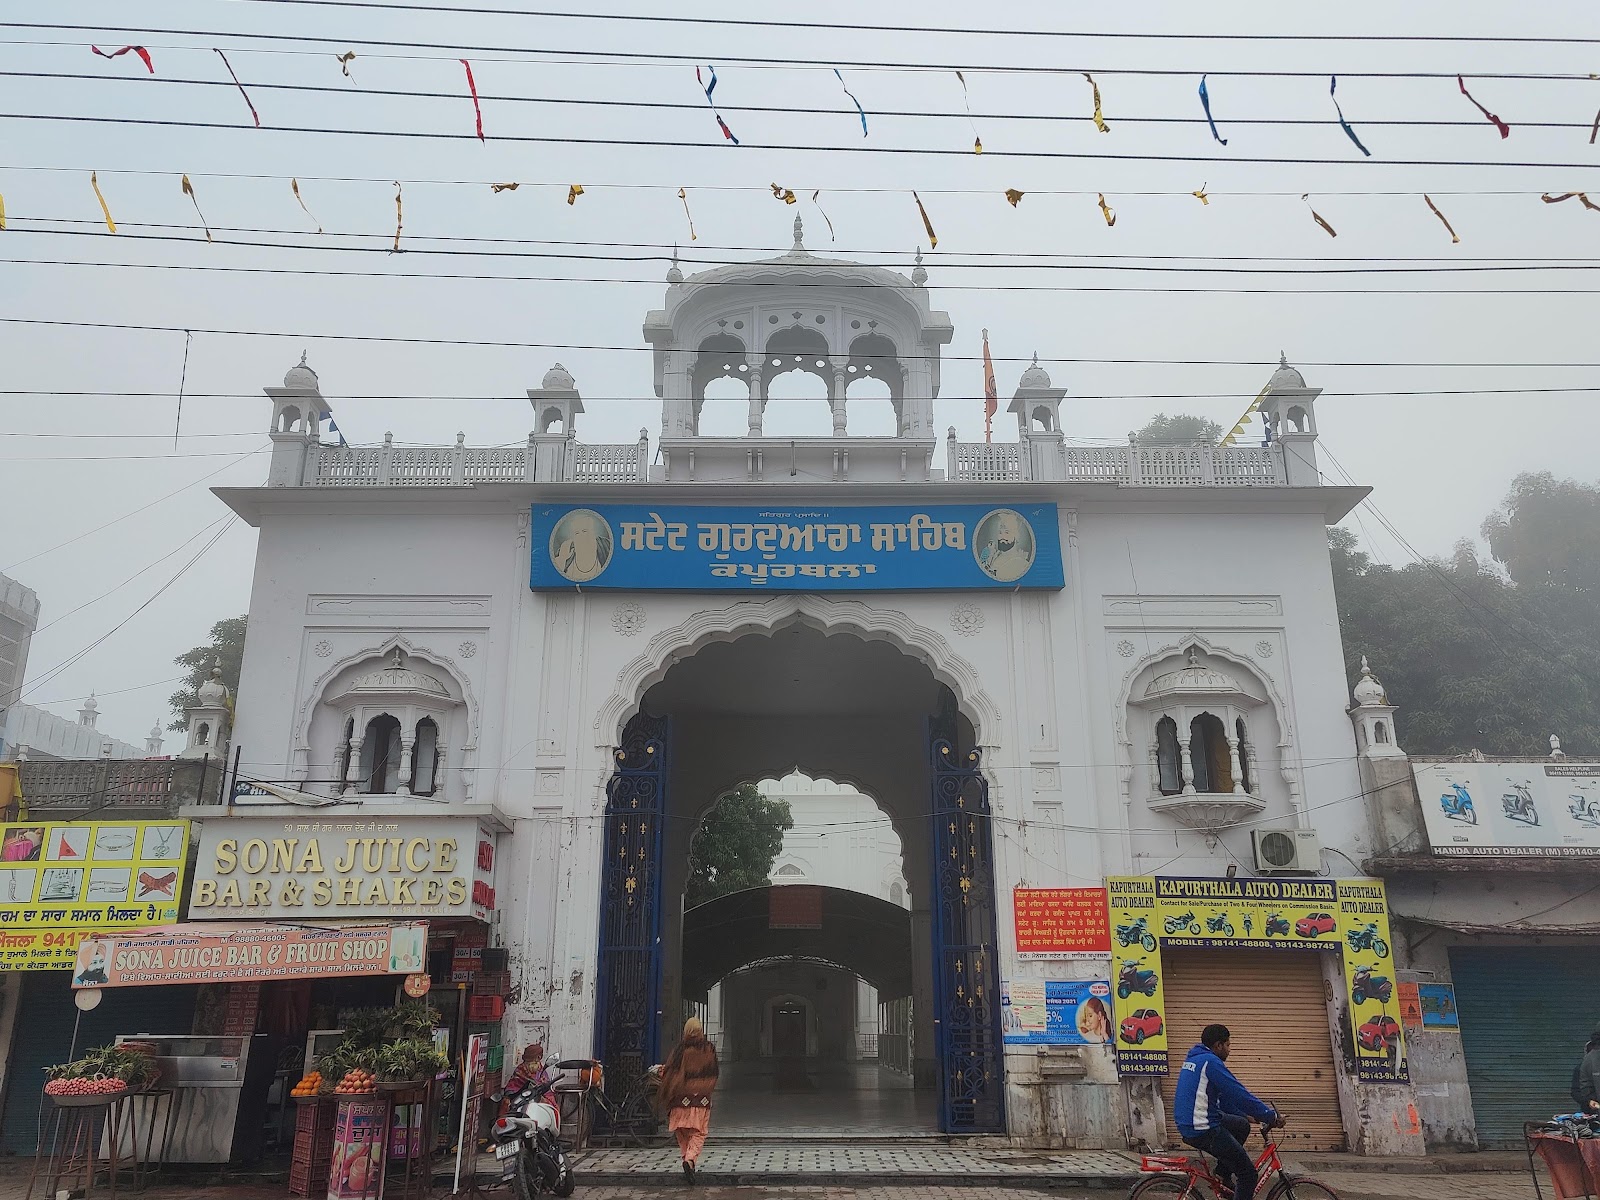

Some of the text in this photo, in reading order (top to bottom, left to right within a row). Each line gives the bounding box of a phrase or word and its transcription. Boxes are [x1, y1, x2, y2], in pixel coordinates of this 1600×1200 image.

[620, 513, 966, 560] ਸਟੇਟ ਗੁਰਦੁਆਰਾ ਸਾਹਿਬ
[709, 563, 878, 585] ਕਪੂਰਥਲਾ
[284, 824, 292, 832] 50
[214, 838, 324, 874] SONA
[334, 838, 458, 873] JUICE
[1473, 848, 1500, 856] AUTO
[1503, 848, 1543, 856] DEALER
[1546, 848, 1561, 857] (M)
[192, 878, 272, 908] BAR
[279, 878, 305, 907] &
[312, 876, 467, 906] SHAKES
[1110, 882, 1154, 894] KAPURTHALA
[1159, 880, 1334, 899] KAPURTHALA AUTO DEALER
[1340, 886, 1383, 898] KAPURTHALA
[1111, 896, 1155, 908] AUTO DEALER
[1341, 902, 1385, 914] AUTO DEALER
[0, 910, 20, 922] ਰਮ
[24, 910, 37, 922] ਦਾ
[41, 910, 67, 922] ਸਾਰਾ
[71, 910, 102, 922] ਸਮਾਨ
[106, 906, 142, 921] ਮਿਲਦਾ
[1167, 938, 1204, 946] MOBILE
[1275, 941, 1335, 950] 98143-98745
[115, 940, 388, 971] SONA JUICE BAR & FRUIT SHOP
[1120, 1053, 1167, 1061] 98141-48808
[1120, 1064, 1168, 1072] 98143-98745
